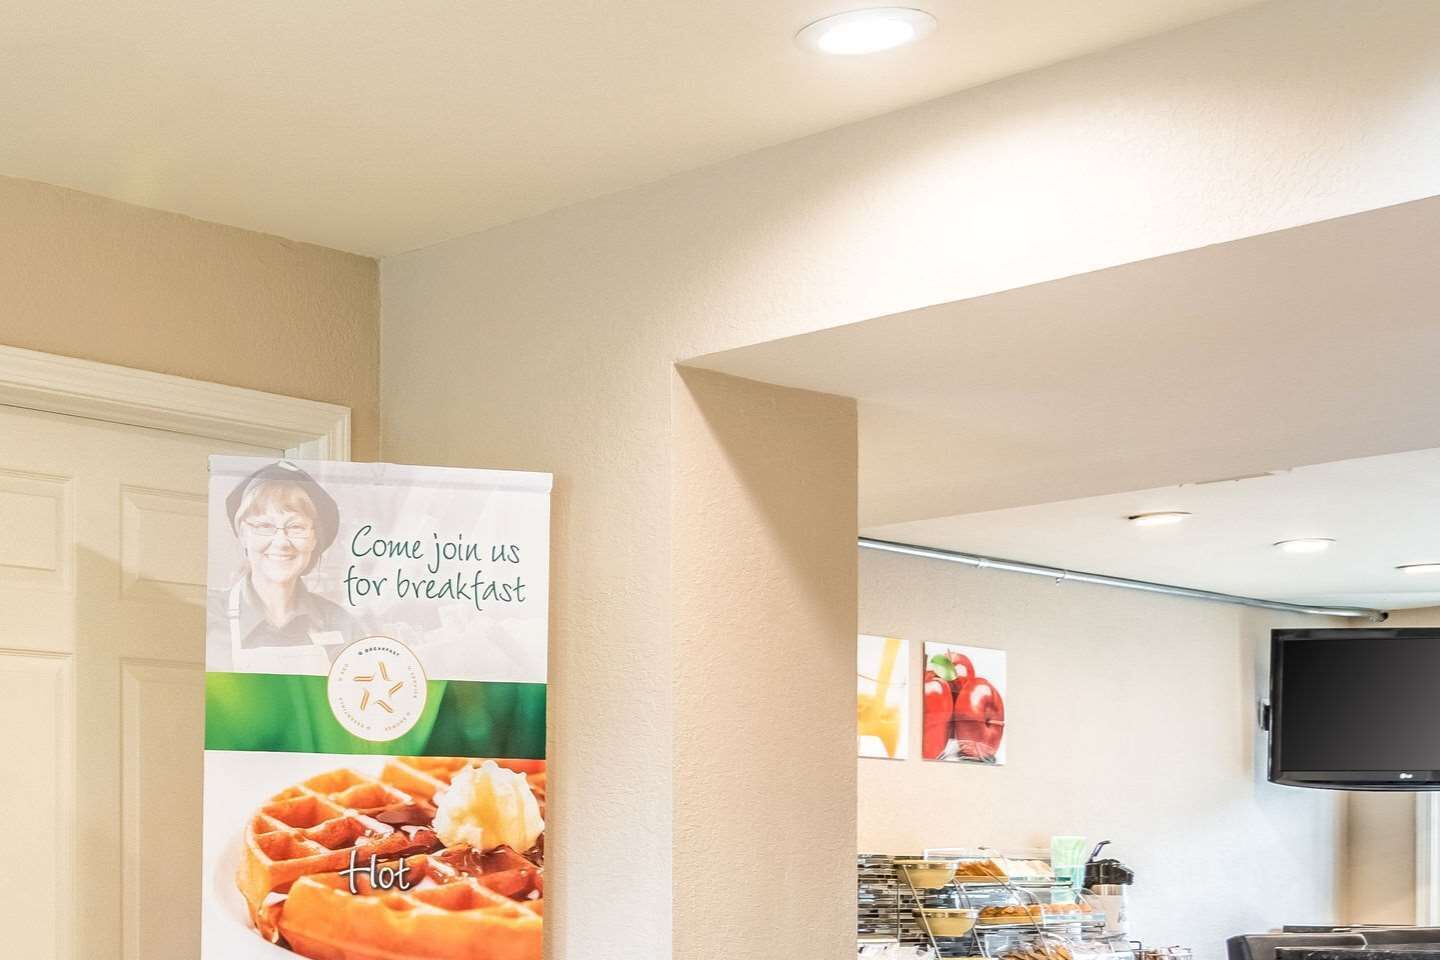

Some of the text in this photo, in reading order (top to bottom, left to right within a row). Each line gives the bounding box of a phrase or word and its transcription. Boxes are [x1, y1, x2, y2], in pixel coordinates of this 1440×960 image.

[351, 525, 521, 573] Come join us
[344, 565, 527, 612] for breakfast
[339, 849, 411, 893] Hot
